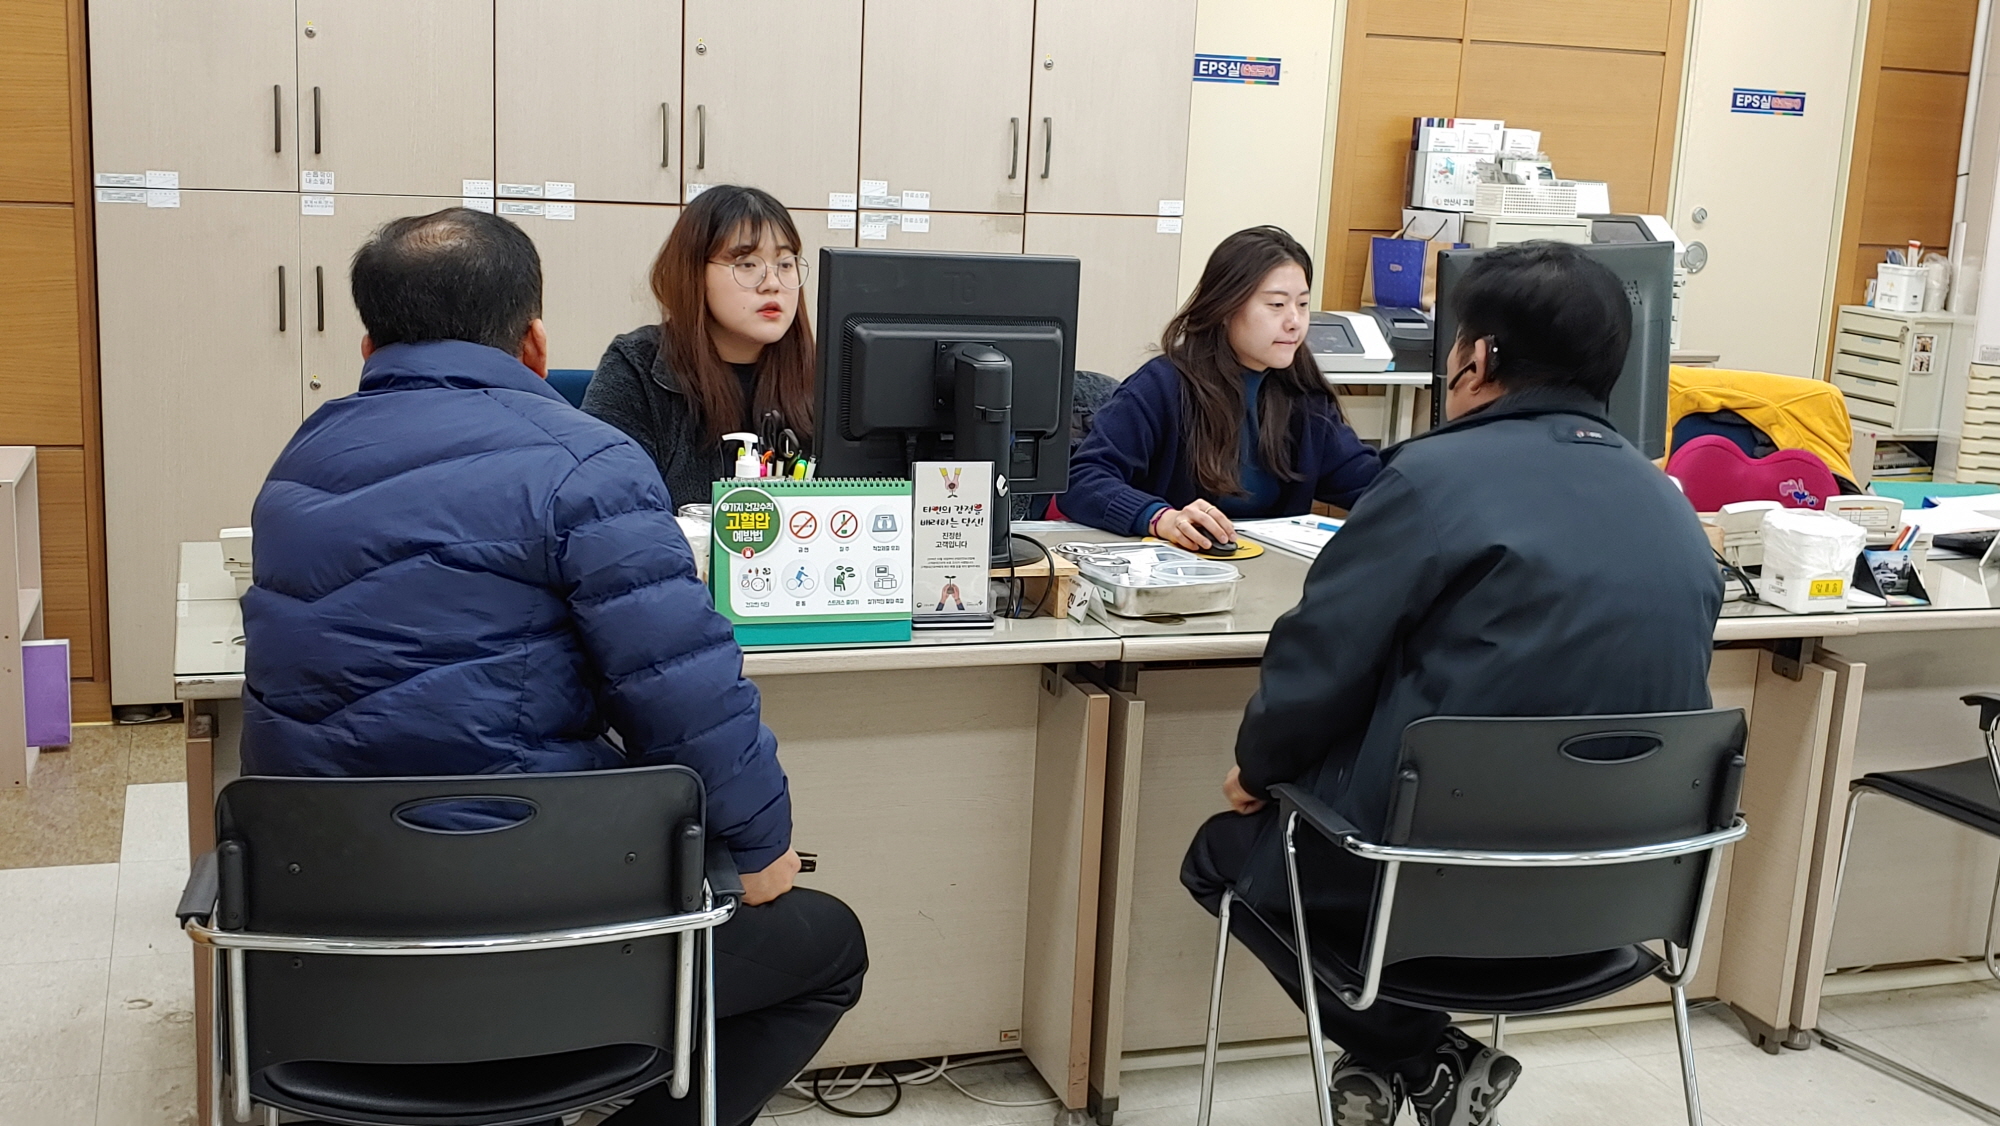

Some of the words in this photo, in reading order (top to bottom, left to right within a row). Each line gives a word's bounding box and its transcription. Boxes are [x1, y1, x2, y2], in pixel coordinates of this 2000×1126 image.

[1199, 61, 1240, 77] EPS실
[1736, 94, 1771, 109] EPS실
[922, 505, 951, 515] 타인의
[953, 503, 983, 516] 감정을
[725, 512, 771, 530] 고혈압
[920, 517, 959, 529] 배려하는
[961, 517, 984, 527] 당신!
[732, 530, 763, 542] 예방법
[935, 540, 968, 549] 고객입니다
